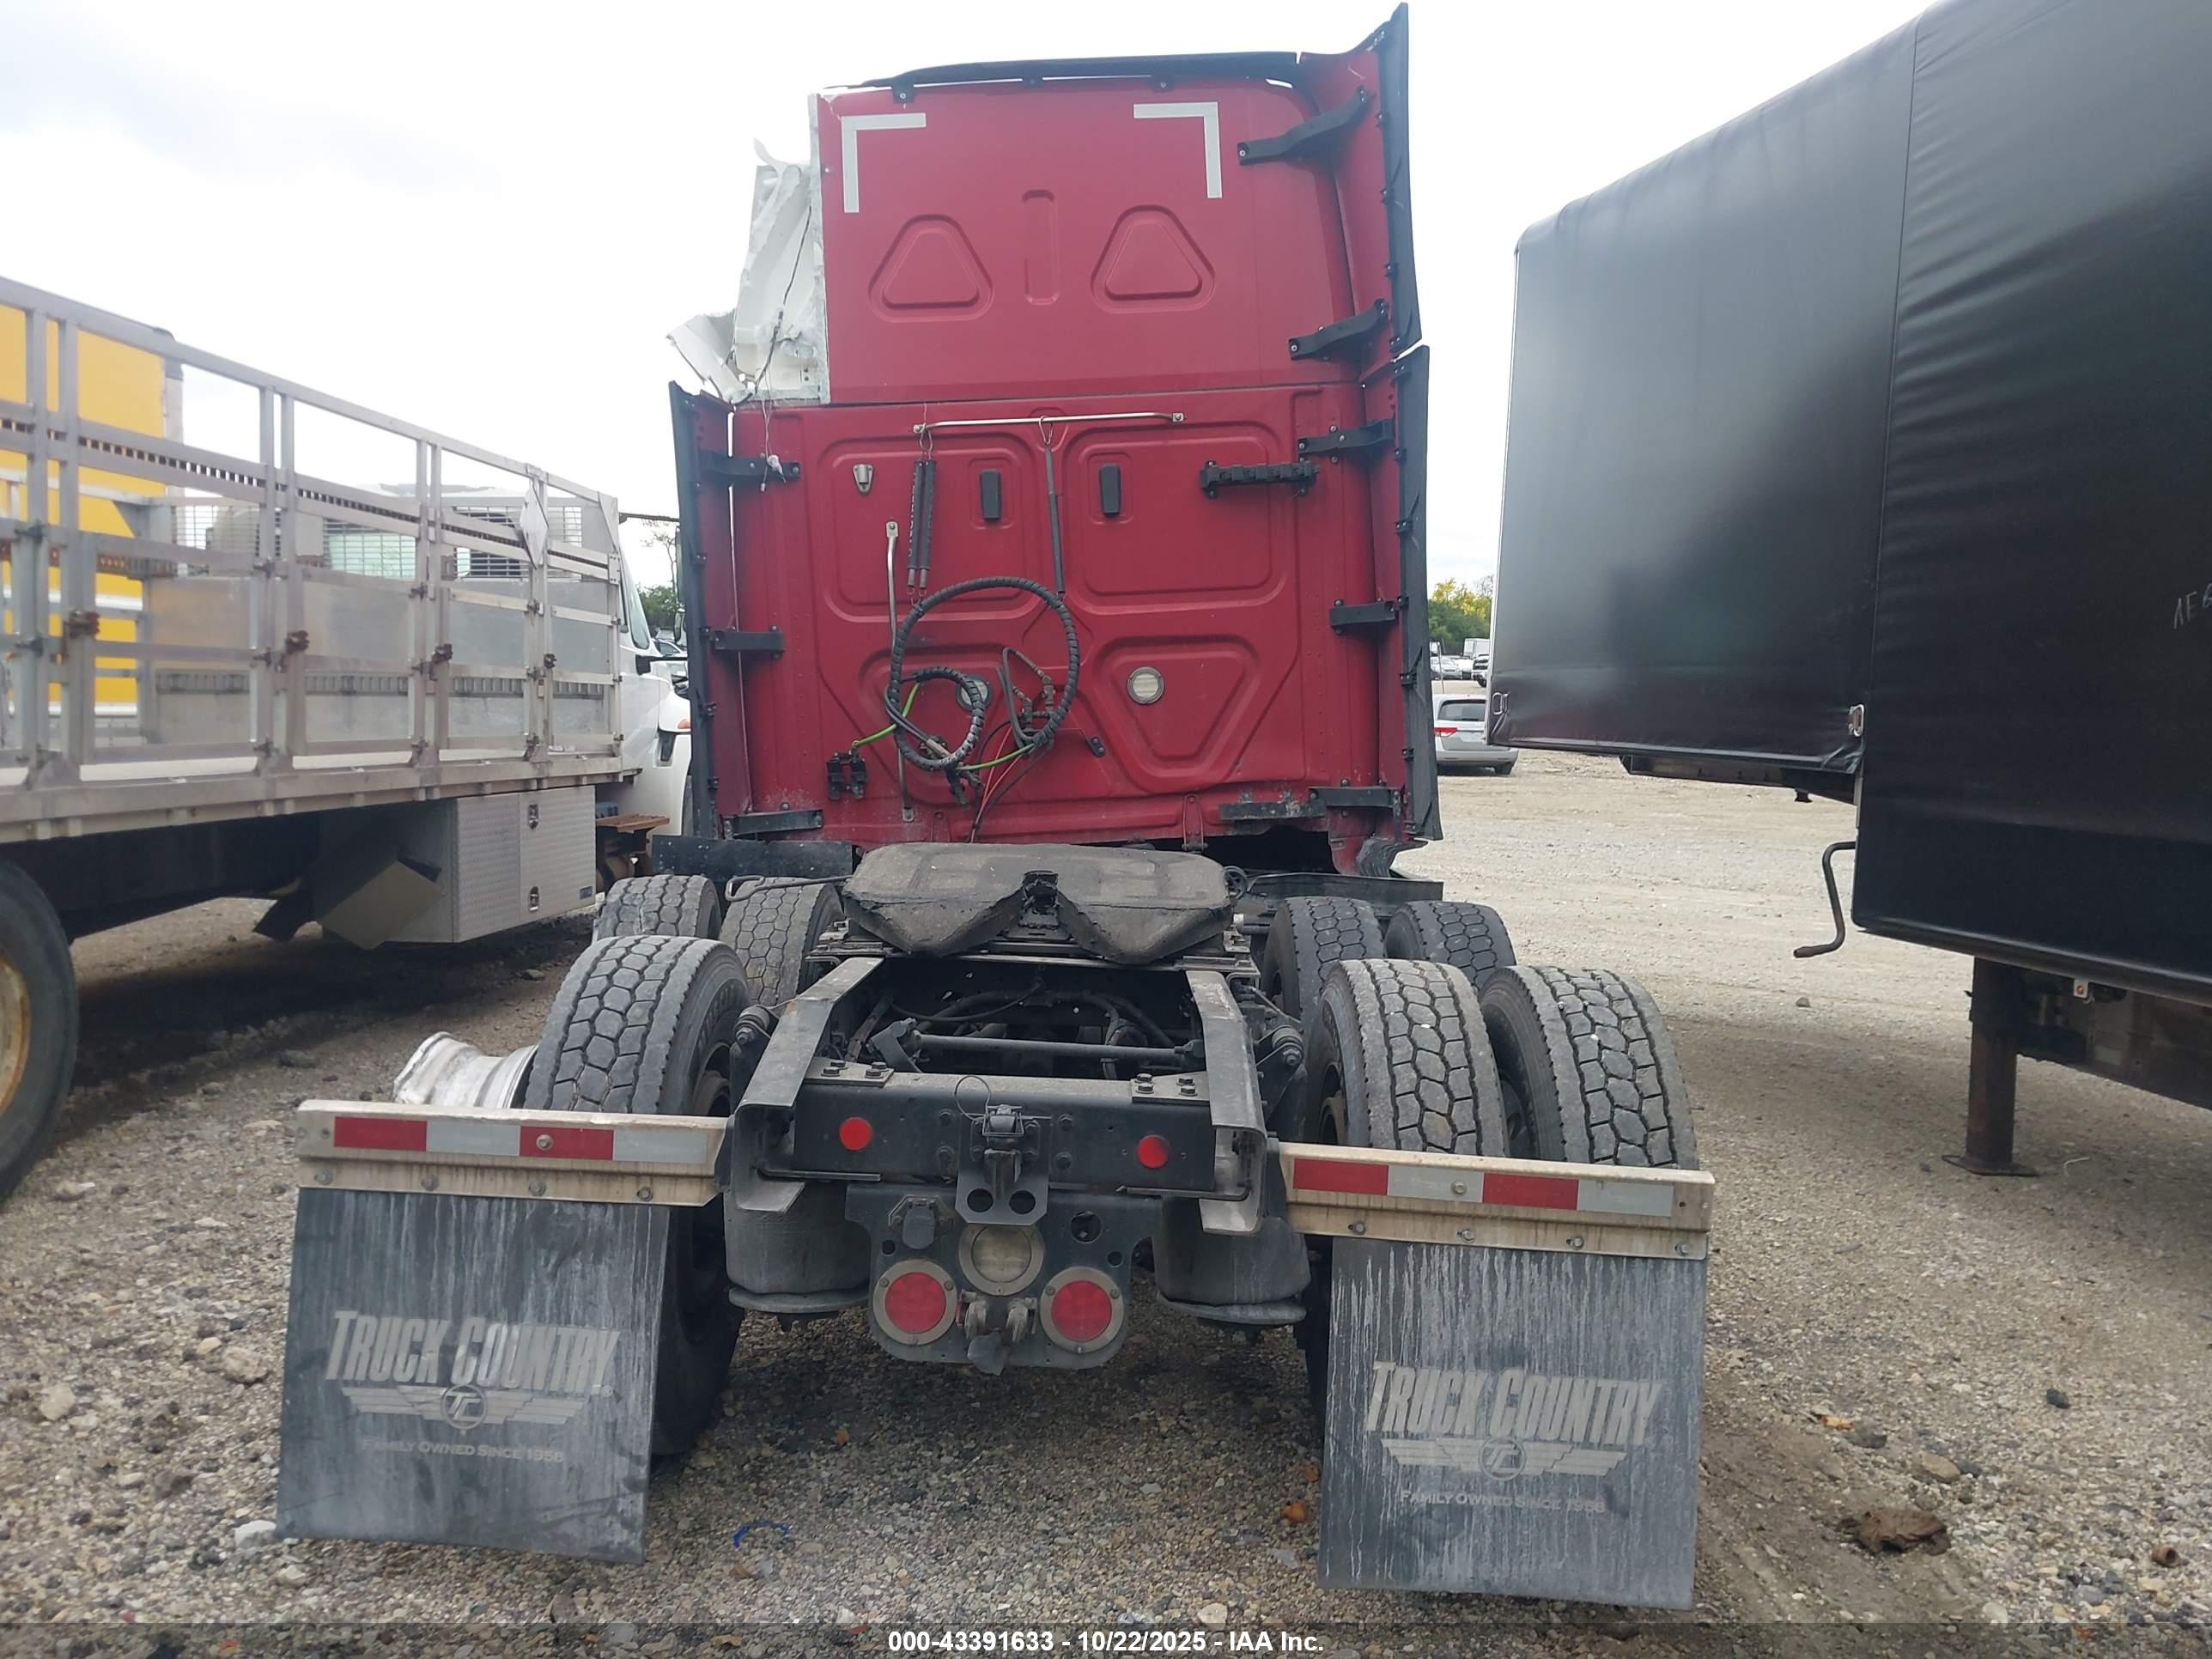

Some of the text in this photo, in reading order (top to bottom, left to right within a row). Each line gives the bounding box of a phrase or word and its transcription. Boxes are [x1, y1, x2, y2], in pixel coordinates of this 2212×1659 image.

[325, 1310, 620, 1393] TRUCK COUNTRY
[1364, 1361, 1663, 1445] TRUCK COUNTRY
[362, 1438, 416, 1453] FAMILY
[418, 1441, 475, 1456] OWNED
[477, 1444, 525, 1460] SINCE
[1400, 1490, 1453, 1505] FAMILY
[1455, 1492, 1512, 1507] OWNED
[1514, 1495, 1561, 1510] SINCE
